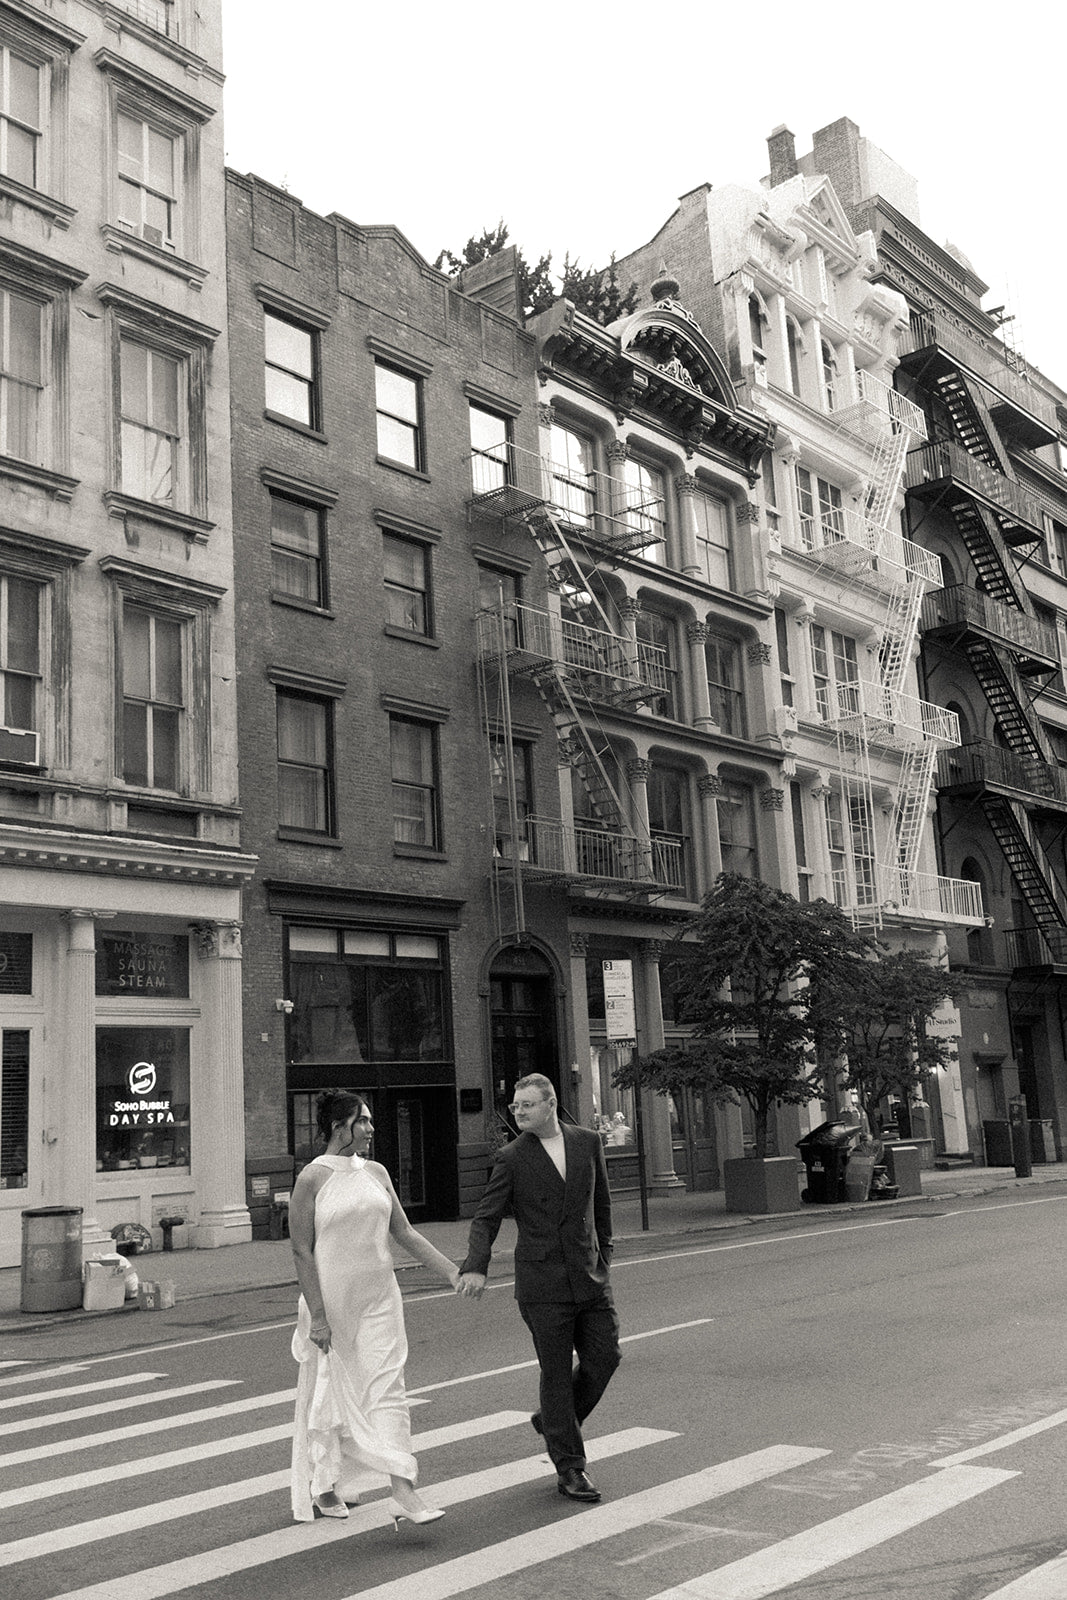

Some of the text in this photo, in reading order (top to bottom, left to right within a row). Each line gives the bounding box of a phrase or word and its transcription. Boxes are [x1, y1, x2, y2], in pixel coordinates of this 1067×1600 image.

[114, 942, 172, 957] MASSAGE
[119, 959, 167, 971] SAUNA
[605, 961, 612, 970] 3
[119, 974, 166, 988] STEAM
[607, 1001, 614, 1009] 2
[110, 1112, 175, 1126] DAY SPA
